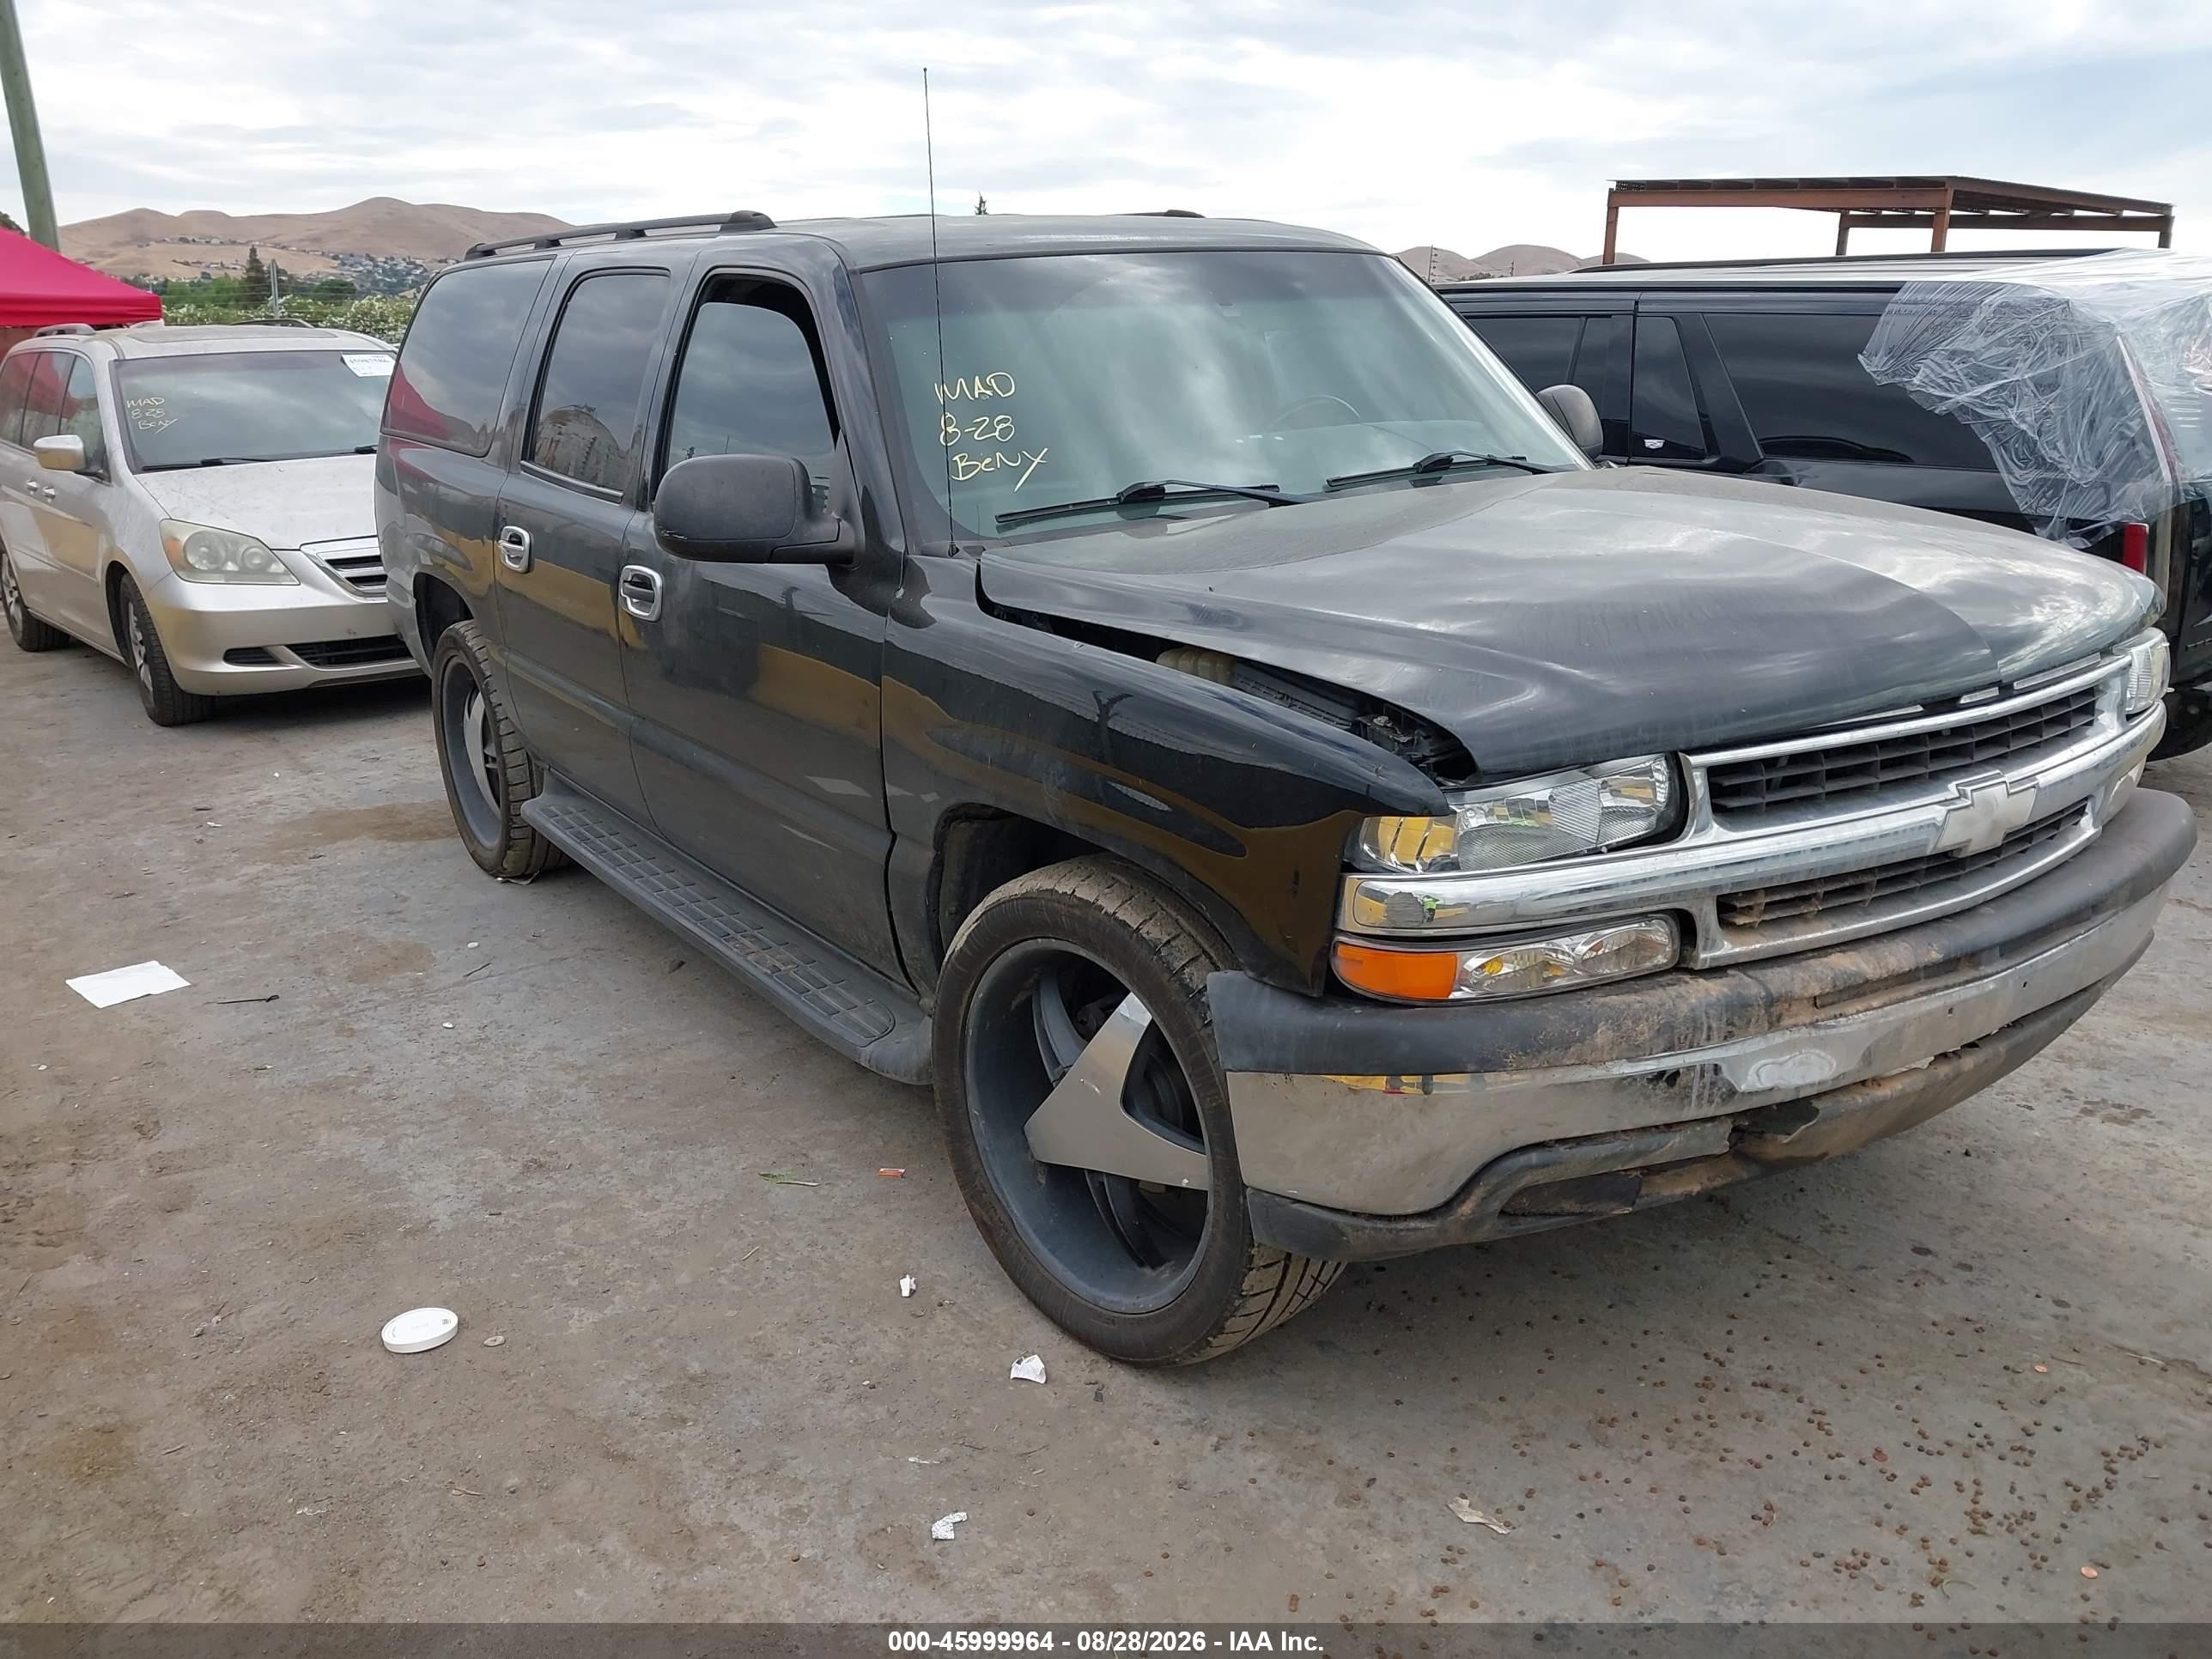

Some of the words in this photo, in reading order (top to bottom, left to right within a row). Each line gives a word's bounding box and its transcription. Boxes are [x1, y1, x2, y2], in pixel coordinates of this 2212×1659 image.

[126, 397, 165, 408] MAD
[934, 372, 1015, 405] MAD
[939, 412, 1015, 446] 8-28
